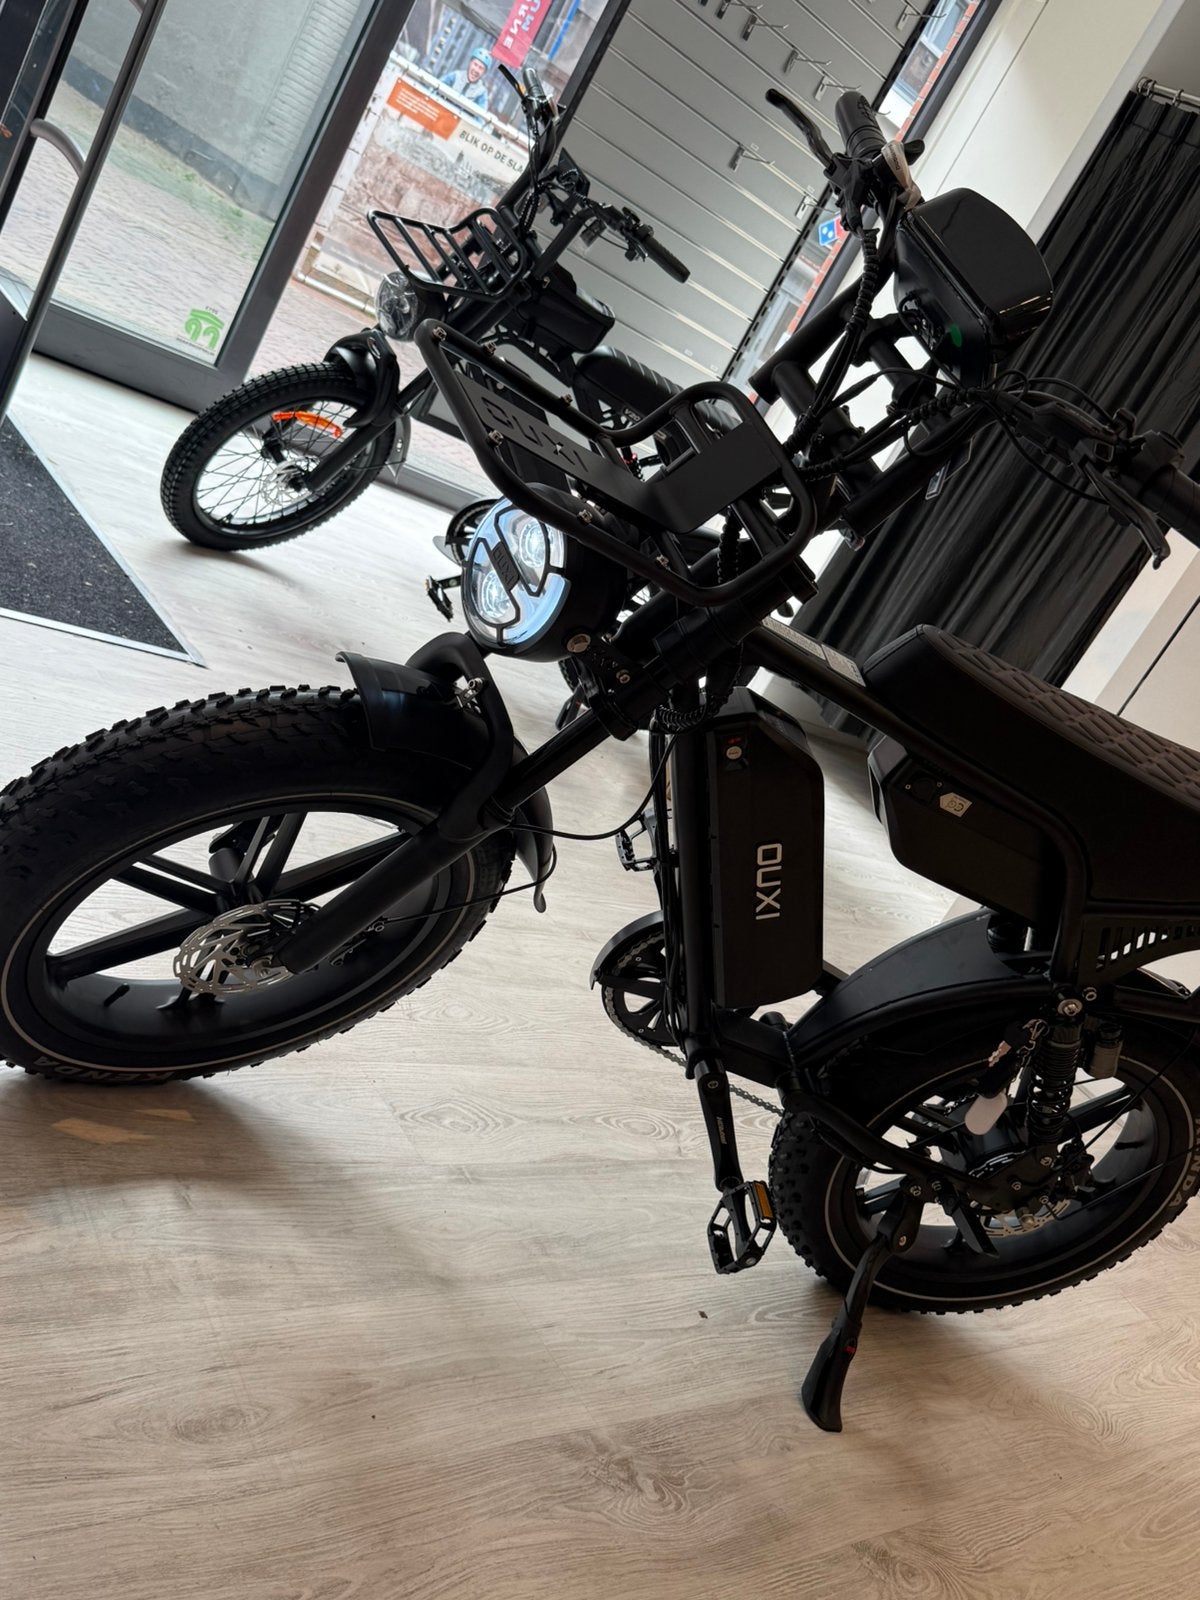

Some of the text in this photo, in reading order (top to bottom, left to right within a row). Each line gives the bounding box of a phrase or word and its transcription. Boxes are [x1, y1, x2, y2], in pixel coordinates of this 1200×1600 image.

[459, 130, 480, 148] BLIK
[481, 143, 494, 154] OP
[494, 150, 508, 163] DE
[624, 407, 641, 421] V20
[755, 842, 783, 920] OUXI
